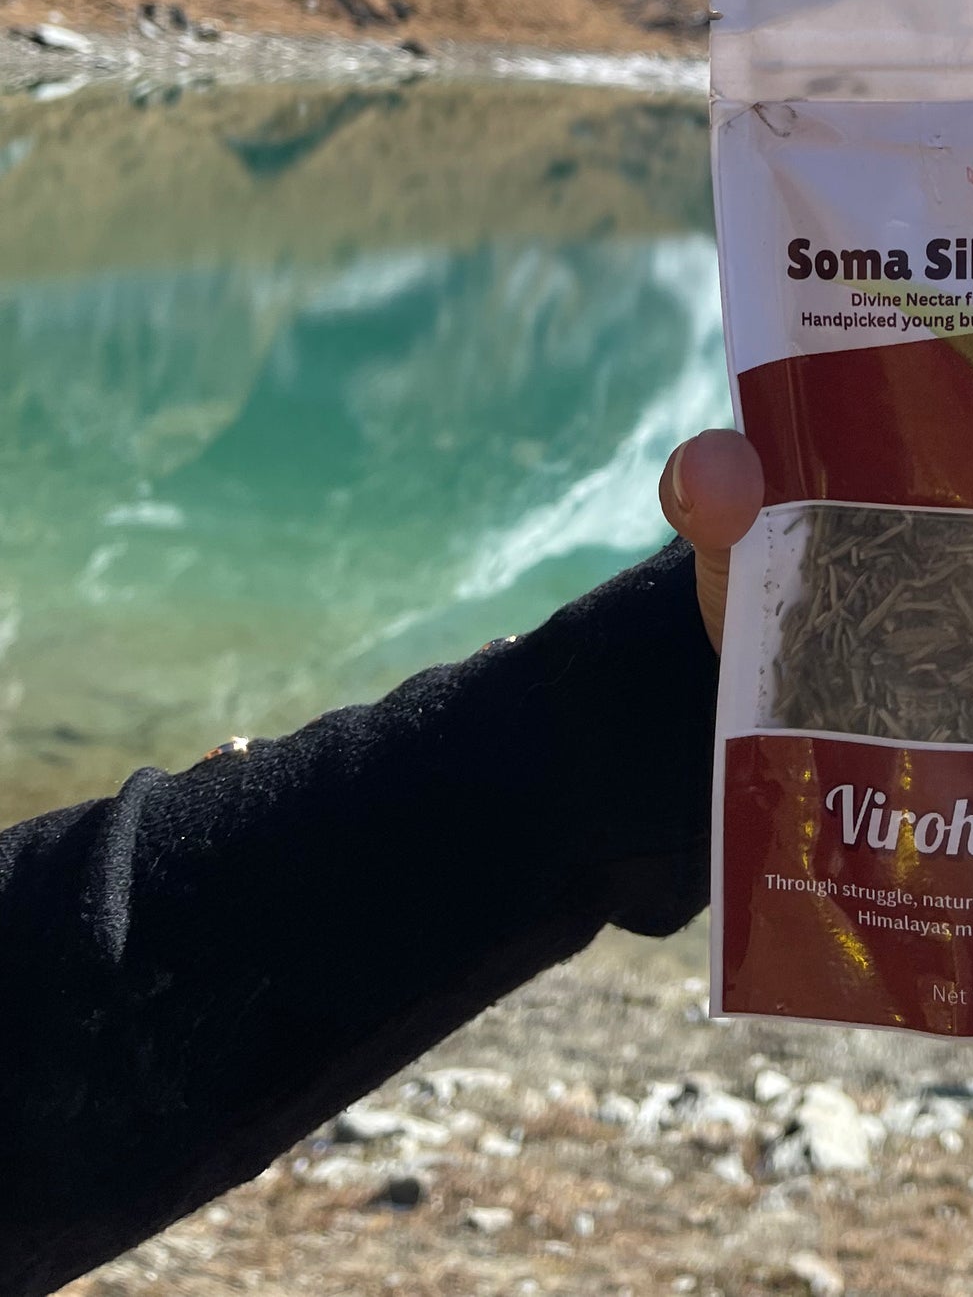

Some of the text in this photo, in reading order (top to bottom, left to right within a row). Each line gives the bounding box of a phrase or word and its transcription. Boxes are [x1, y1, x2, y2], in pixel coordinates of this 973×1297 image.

[787, 238, 912, 280] Soma
[851, 292, 901, 307] Divine
[906, 292, 961, 307] Nectar
[801, 312, 897, 330] Handpicked
[901, 315, 954, 331] young
[765, 874, 837, 897] Through
[842, 883, 918, 908] struggle,
[858, 910, 950, 937] Himalayas
[933, 984, 966, 1005] Net
